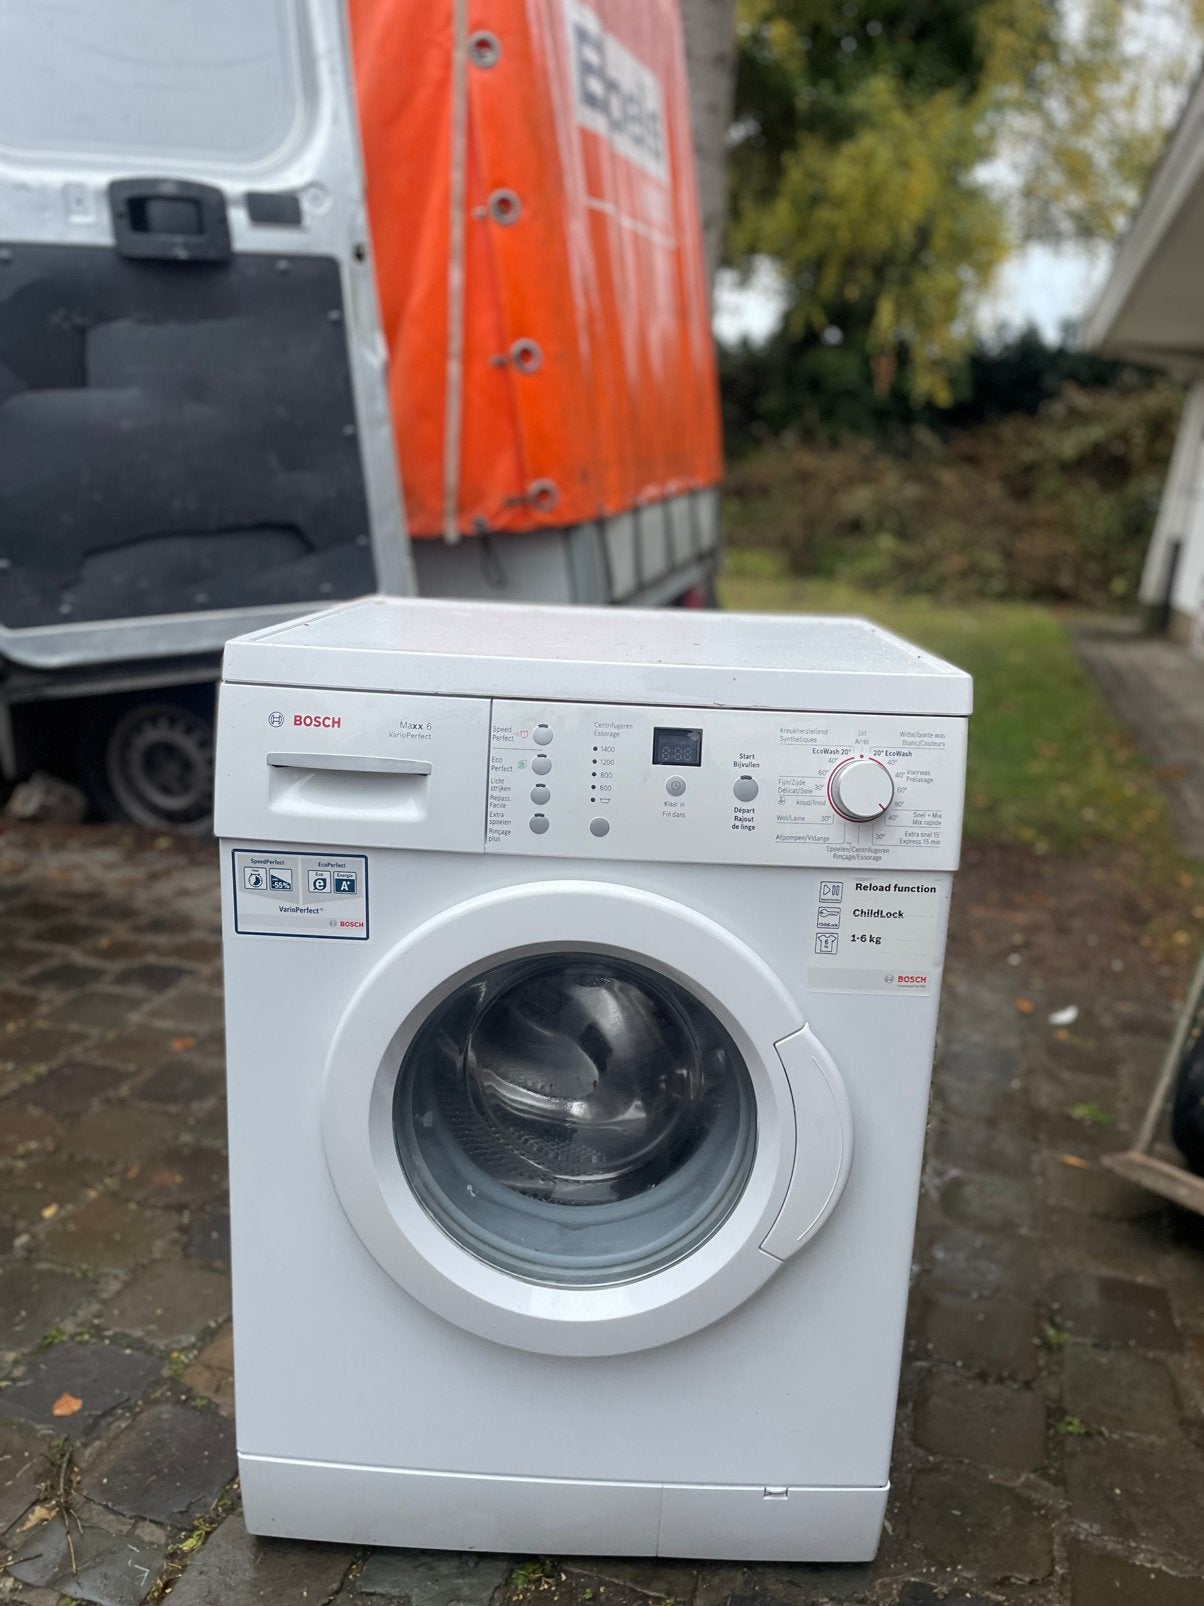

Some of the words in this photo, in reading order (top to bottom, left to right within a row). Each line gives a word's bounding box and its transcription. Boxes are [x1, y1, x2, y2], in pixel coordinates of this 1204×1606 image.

[293, 714, 342, 728] BOSCH
[400, 721, 423, 730] Maxx
[426, 722, 432, 731] 6
[492, 726, 512, 734] Speed
[594, 722, 634, 730] Centrifugeren
[388, 731, 432, 740] VarioPerfect
[734, 807, 755, 815] Départ
[776, 834, 830, 842] Afpompen/Vidange
[826, 846, 890, 854] Spoelen/Centrifugeren
[855, 882, 892, 892] Reload
[894, 884, 936, 894] function
[852, 908, 904, 918] ChildLock
[850, 934, 867, 942] 1-6
[869, 934, 882, 944] kg
[898, 976, 926, 984] BOSCH
